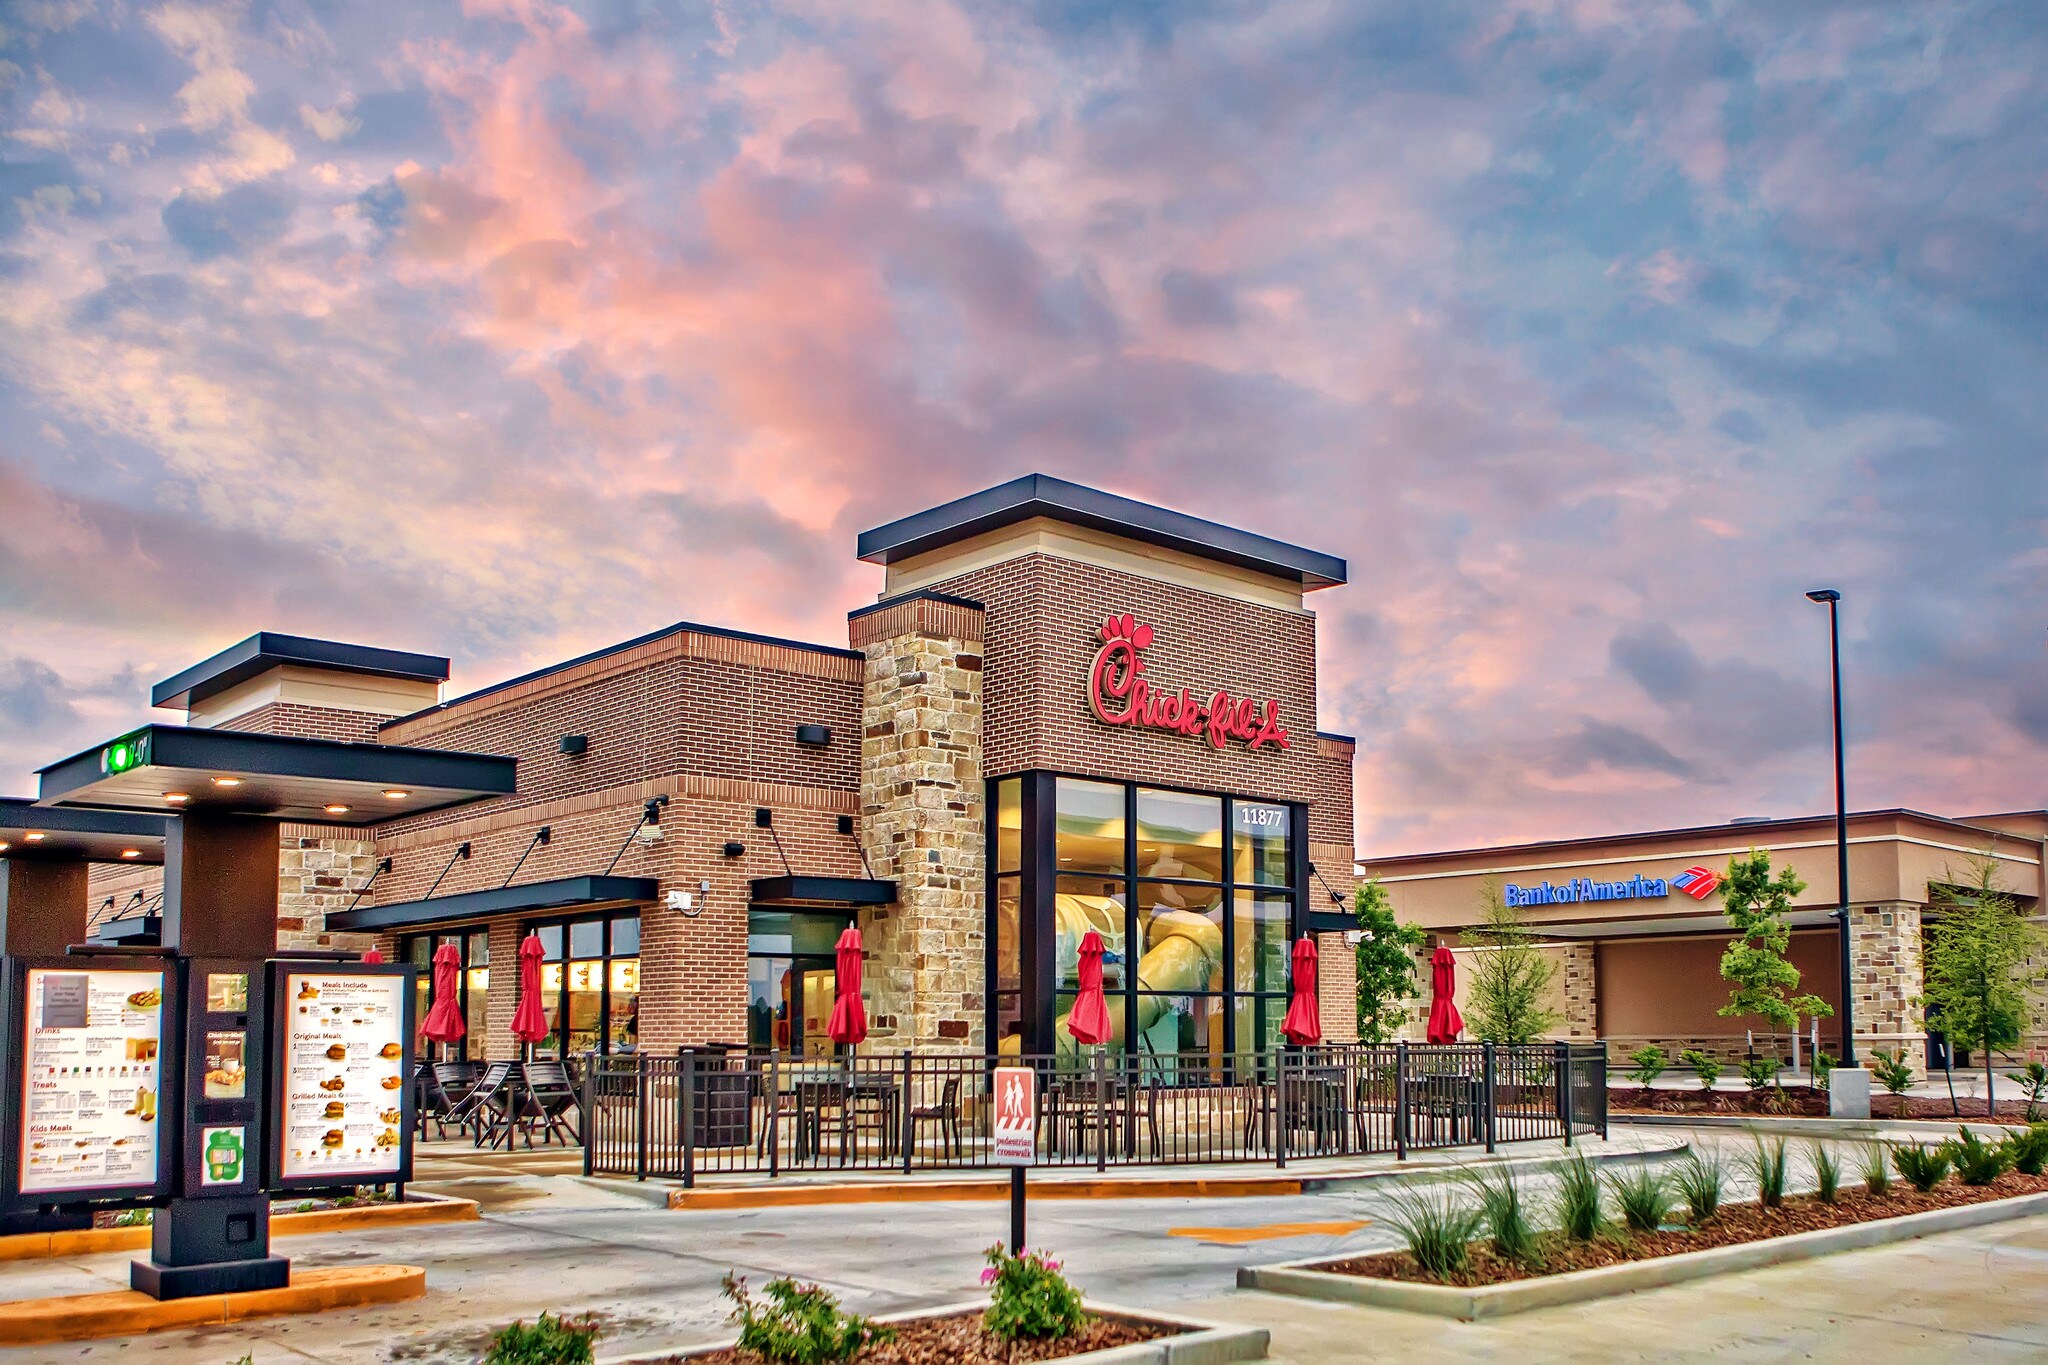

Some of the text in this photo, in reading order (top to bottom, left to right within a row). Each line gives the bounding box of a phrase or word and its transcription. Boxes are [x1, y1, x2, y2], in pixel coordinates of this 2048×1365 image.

[1087, 613, 1290, 750] Chick-fil-A
[1241, 806, 1284, 828] 11877
[35, 1027, 61, 1035] Drinks
[32, 1081, 57, 1089] Treats
[30, 1124, 72, 1133] Kids Meals
[996, 1136, 1032, 1147] pedestrian
[996, 1148, 1032, 1159] crosswalk
